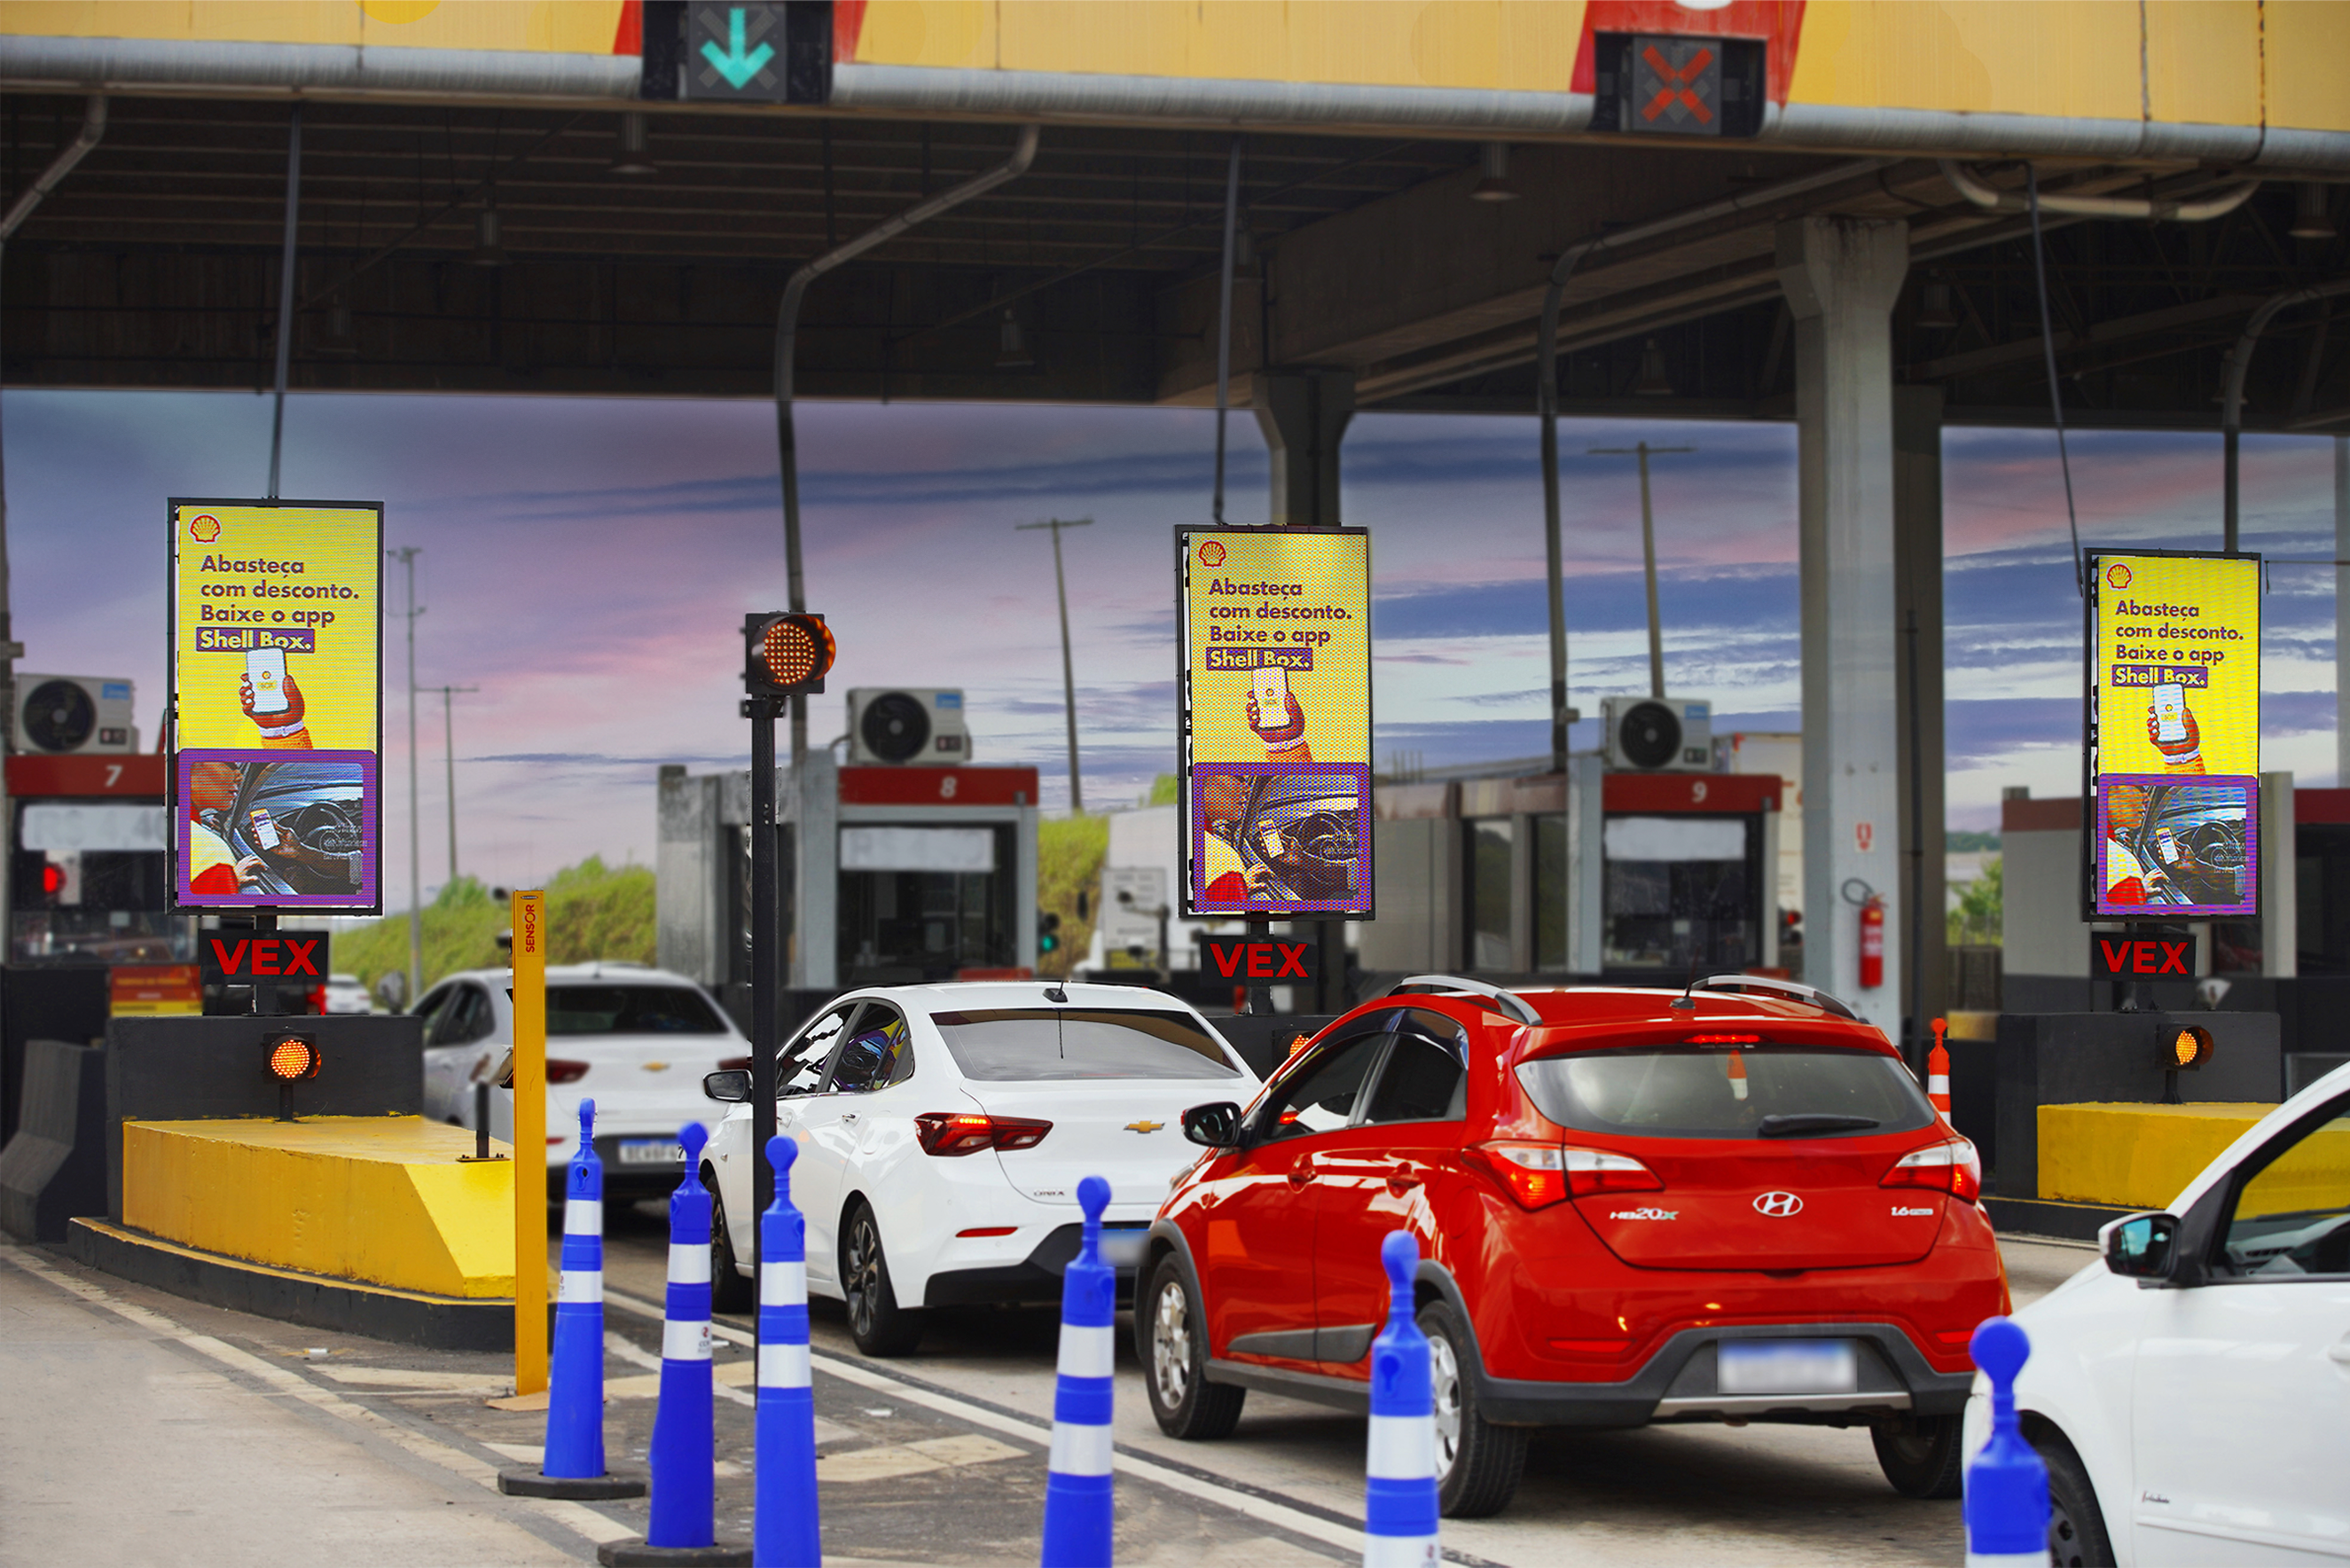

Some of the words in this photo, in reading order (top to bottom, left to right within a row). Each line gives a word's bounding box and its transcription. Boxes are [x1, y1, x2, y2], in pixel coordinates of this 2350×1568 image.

[200, 553, 304, 578] Abasteça
[200, 584, 246, 597] com
[253, 579, 359, 600] desconto.
[1209, 577, 1303, 600] Abasteça
[200, 604, 265, 622] Baixe
[271, 609, 286, 623] o
[292, 610, 335, 628] app
[1210, 606, 1250, 619] com
[1256, 601, 1351, 620] desconto.
[2115, 600, 2200, 622] Abasteça
[200, 629, 255, 648] Shell
[259, 631, 311, 649] Box.
[1210, 624, 1267, 642] Baixe
[1273, 631, 1286, 642] o
[1292, 631, 1331, 647] app
[2115, 626, 2152, 638] com
[2158, 623, 2244, 640] desconto.
[1210, 648, 1257, 668] Shell
[1264, 650, 1310, 668] Box.
[2116, 644, 2168, 661] Baixe
[2173, 649, 2184, 661] o
[2189, 649, 2225, 665] app
[2115, 667, 2158, 684] Shell
[2164, 668, 2205, 686] Box.
[105, 764, 122, 788] 7
[940, 776, 957, 798] 8
[1691, 781, 1707, 804] 9
[524, 904, 537, 953] SENSOR
[210, 938, 320, 976] VEX
[1209, 943, 1309, 978] VEX
[2099, 939, 2189, 975] VEX
